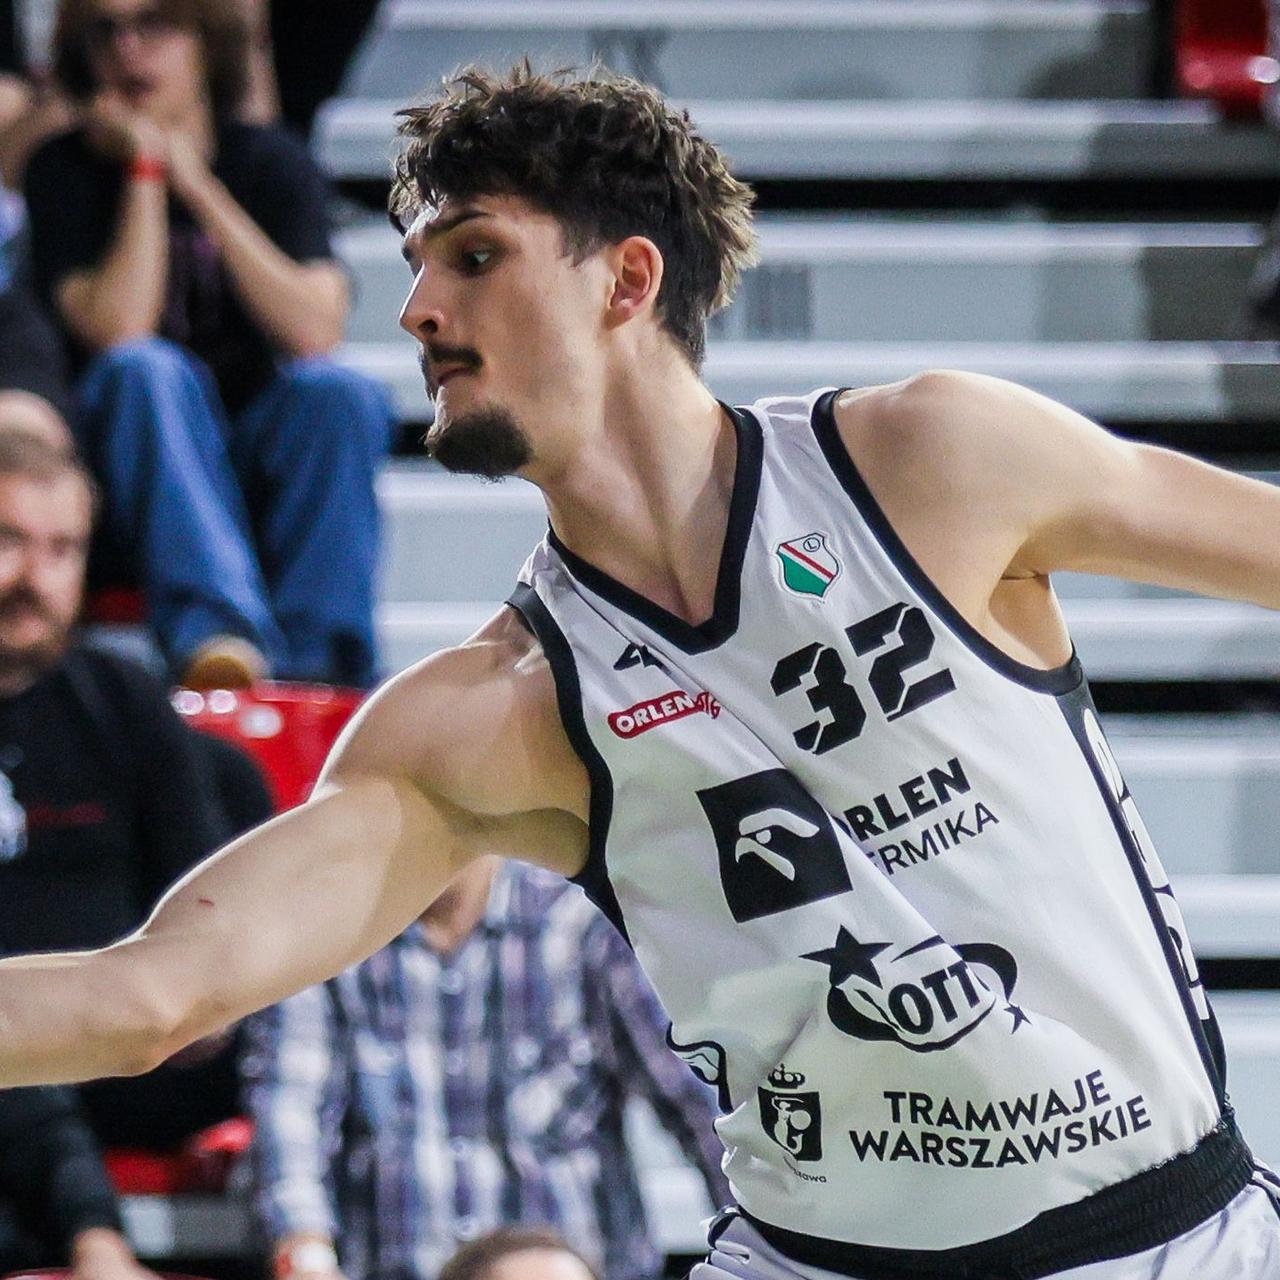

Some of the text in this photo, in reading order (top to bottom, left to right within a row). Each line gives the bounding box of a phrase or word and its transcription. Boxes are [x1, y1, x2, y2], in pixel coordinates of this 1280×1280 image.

[616, 694, 695, 733] ORLEN
[770, 601, 958, 756] 32
[866, 802, 1000, 875] RMIKA
[854, 960, 990, 1035] OTT
[848, 1095, 1152, 1168] WARSZAWSKIE
[883, 1070, 1111, 1132] TRAMWAJE
